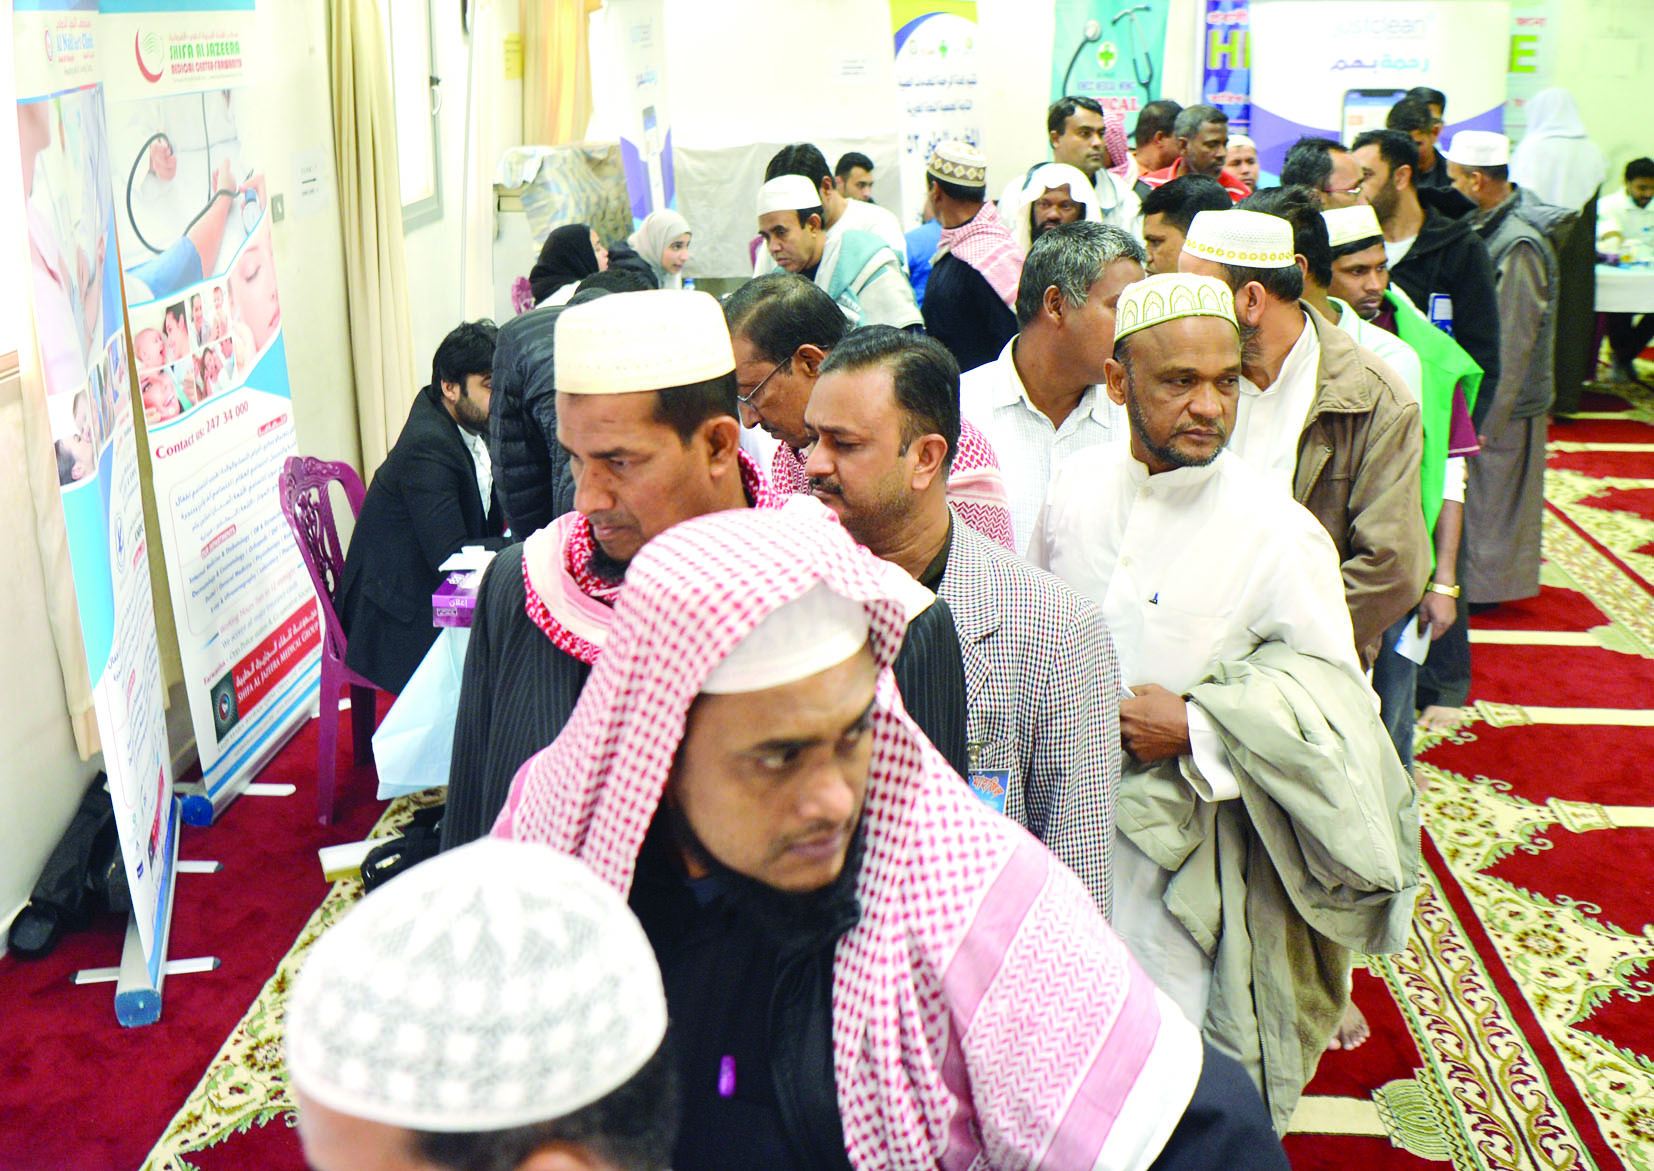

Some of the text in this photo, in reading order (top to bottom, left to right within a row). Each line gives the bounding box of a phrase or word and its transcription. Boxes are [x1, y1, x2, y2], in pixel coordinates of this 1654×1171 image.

[169, 40, 240, 60] SHIFA AL JAZEERA
[1380, 53, 1430, 72] رحمة
[155, 400, 248, 460] Contact us: 247 34 000
[237, 680, 253, 704] SHIFA
[280, 635, 300, 663] MEDICAL
[301, 618, 318, 644] GROUP
